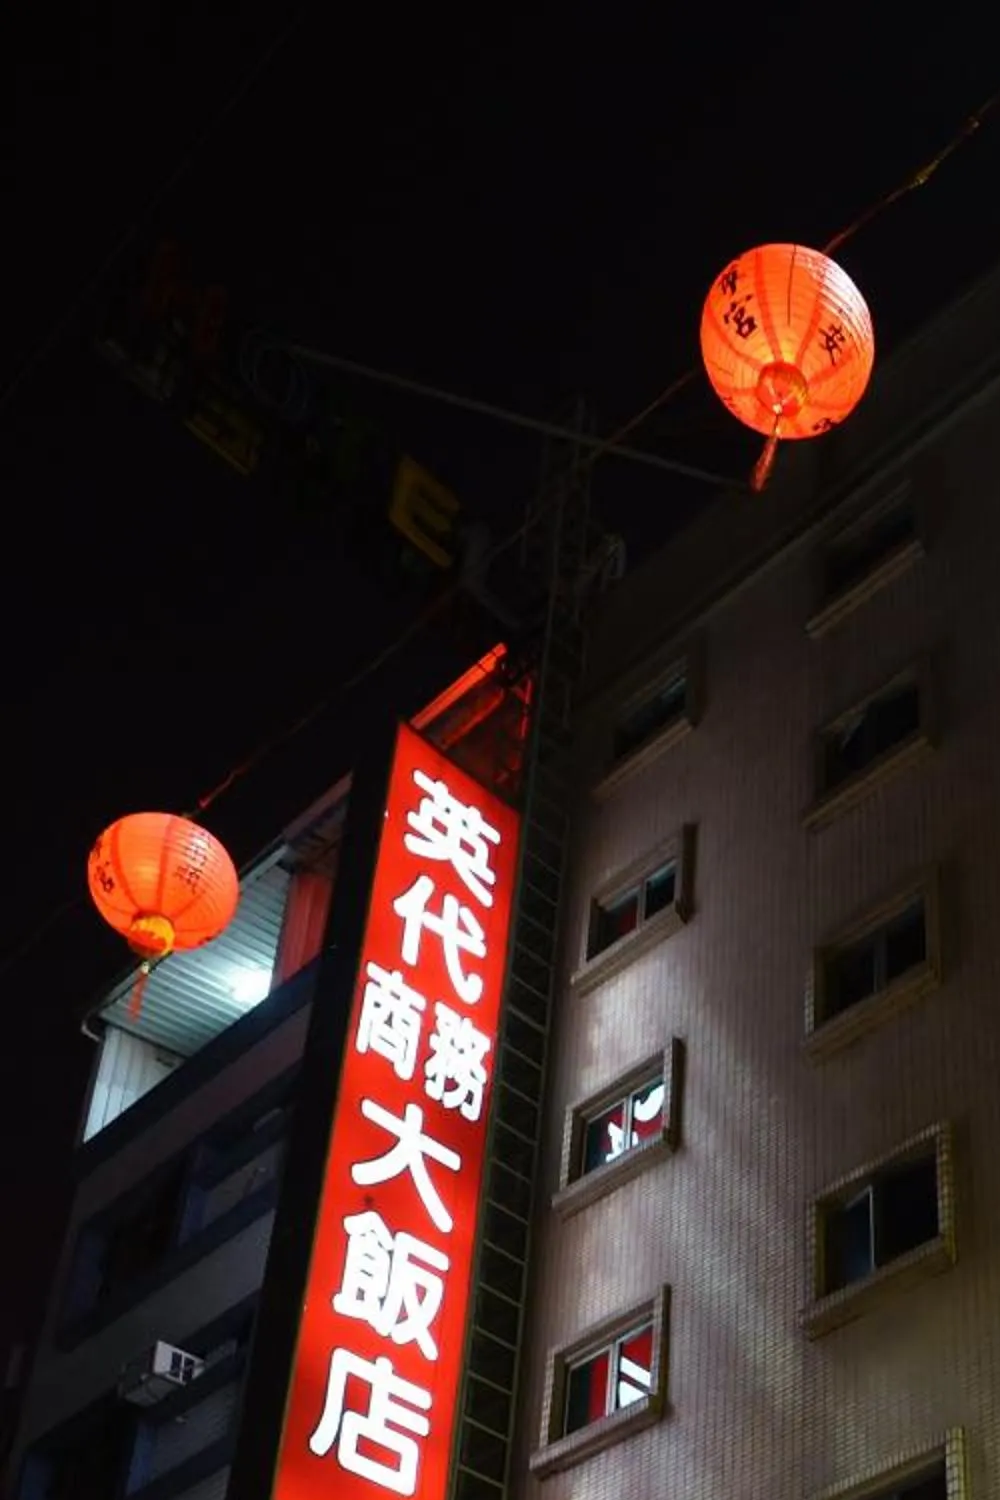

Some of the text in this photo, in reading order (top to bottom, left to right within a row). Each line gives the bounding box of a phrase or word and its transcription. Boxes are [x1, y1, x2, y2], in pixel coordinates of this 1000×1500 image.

[310, 768, 501, 1497] 英代商務大飯店
